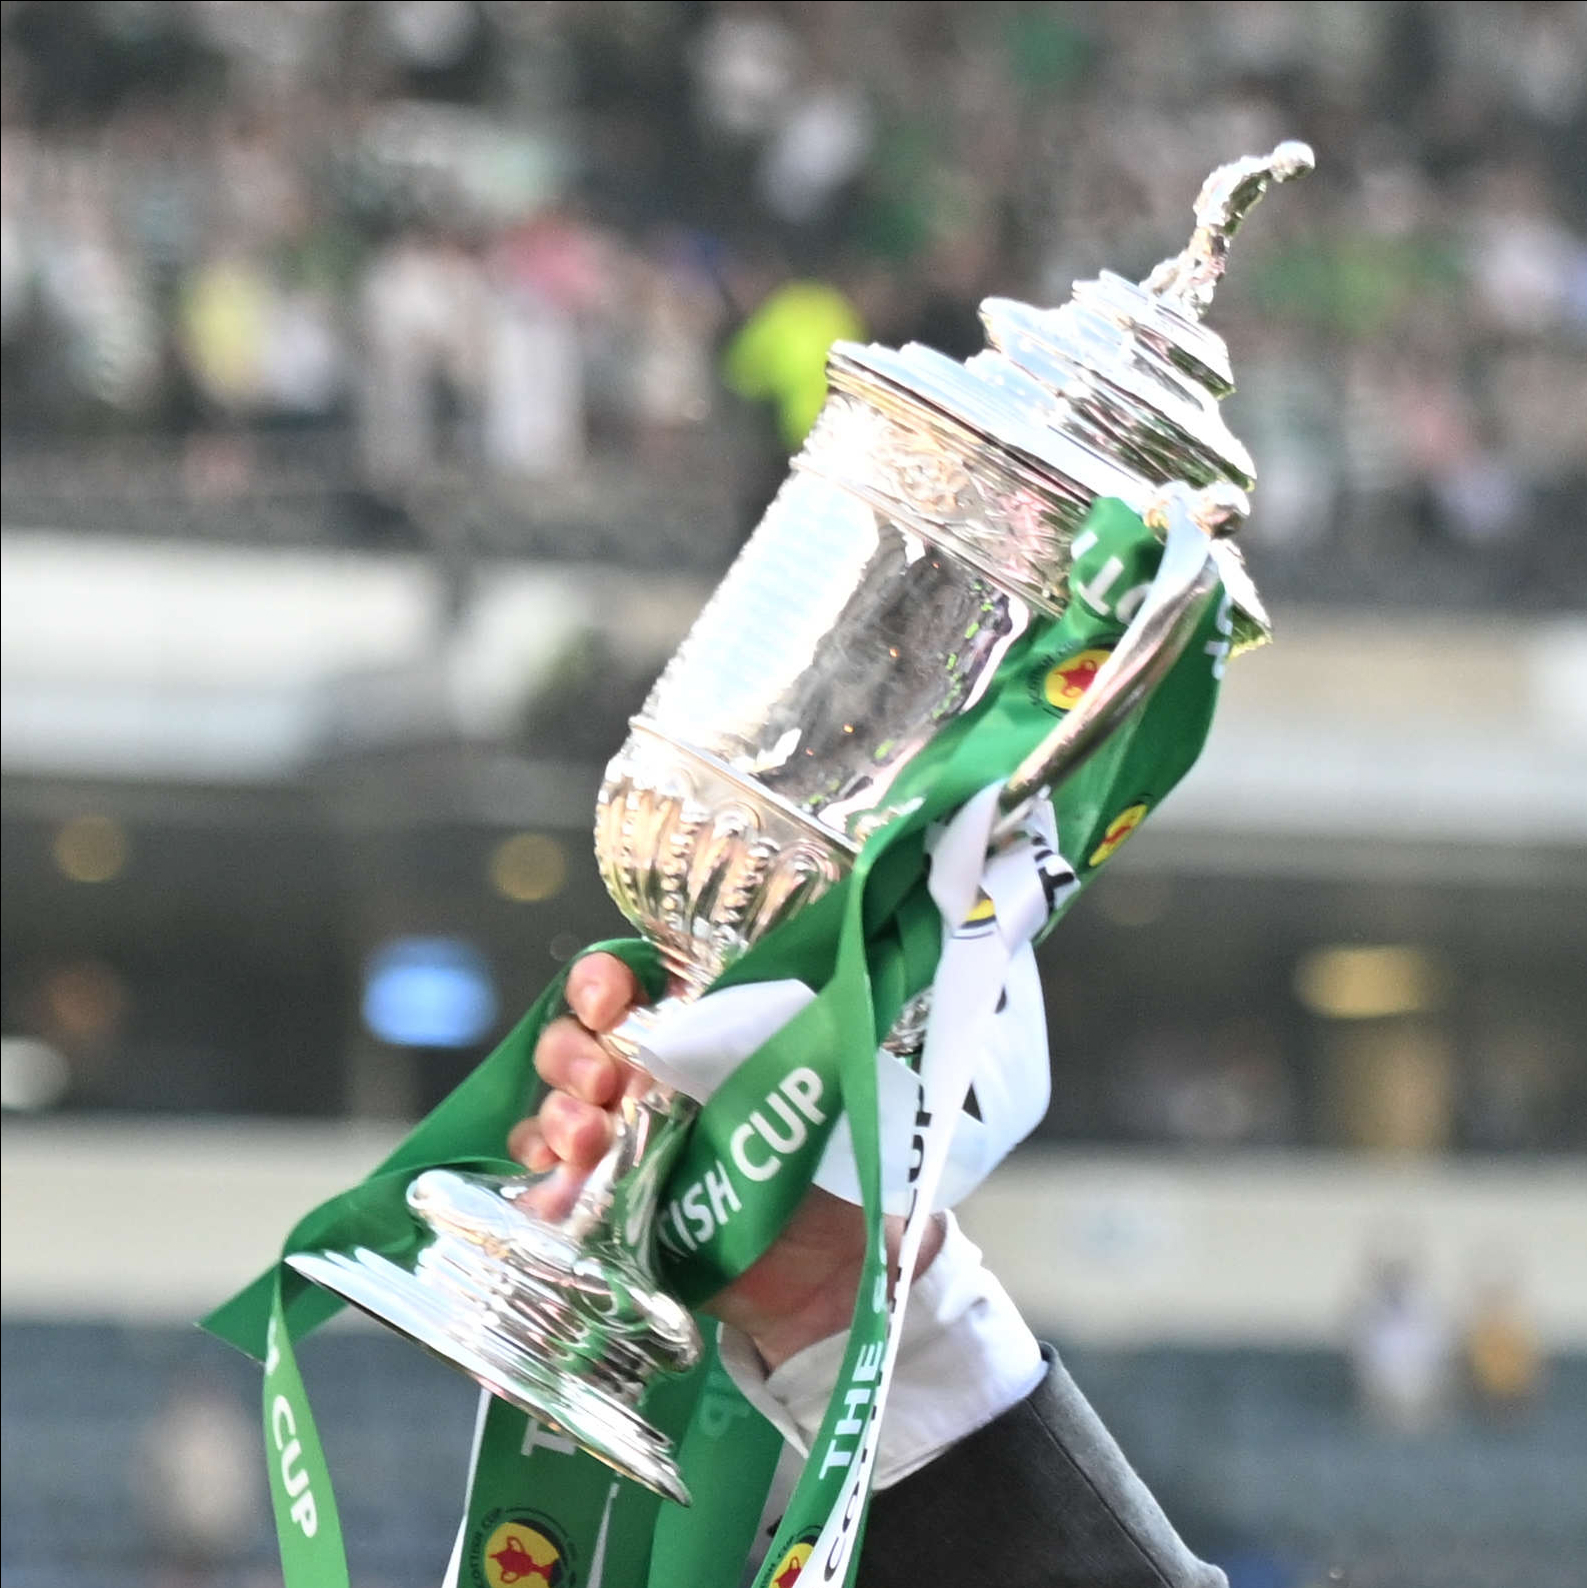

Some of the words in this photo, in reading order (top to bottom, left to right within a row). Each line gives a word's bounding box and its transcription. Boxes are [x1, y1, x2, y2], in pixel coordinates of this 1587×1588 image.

[729, 1066, 827, 1182] CUP
[271, 1394, 318, 1539] CUP
[817, 1340, 884, 1480] THE
